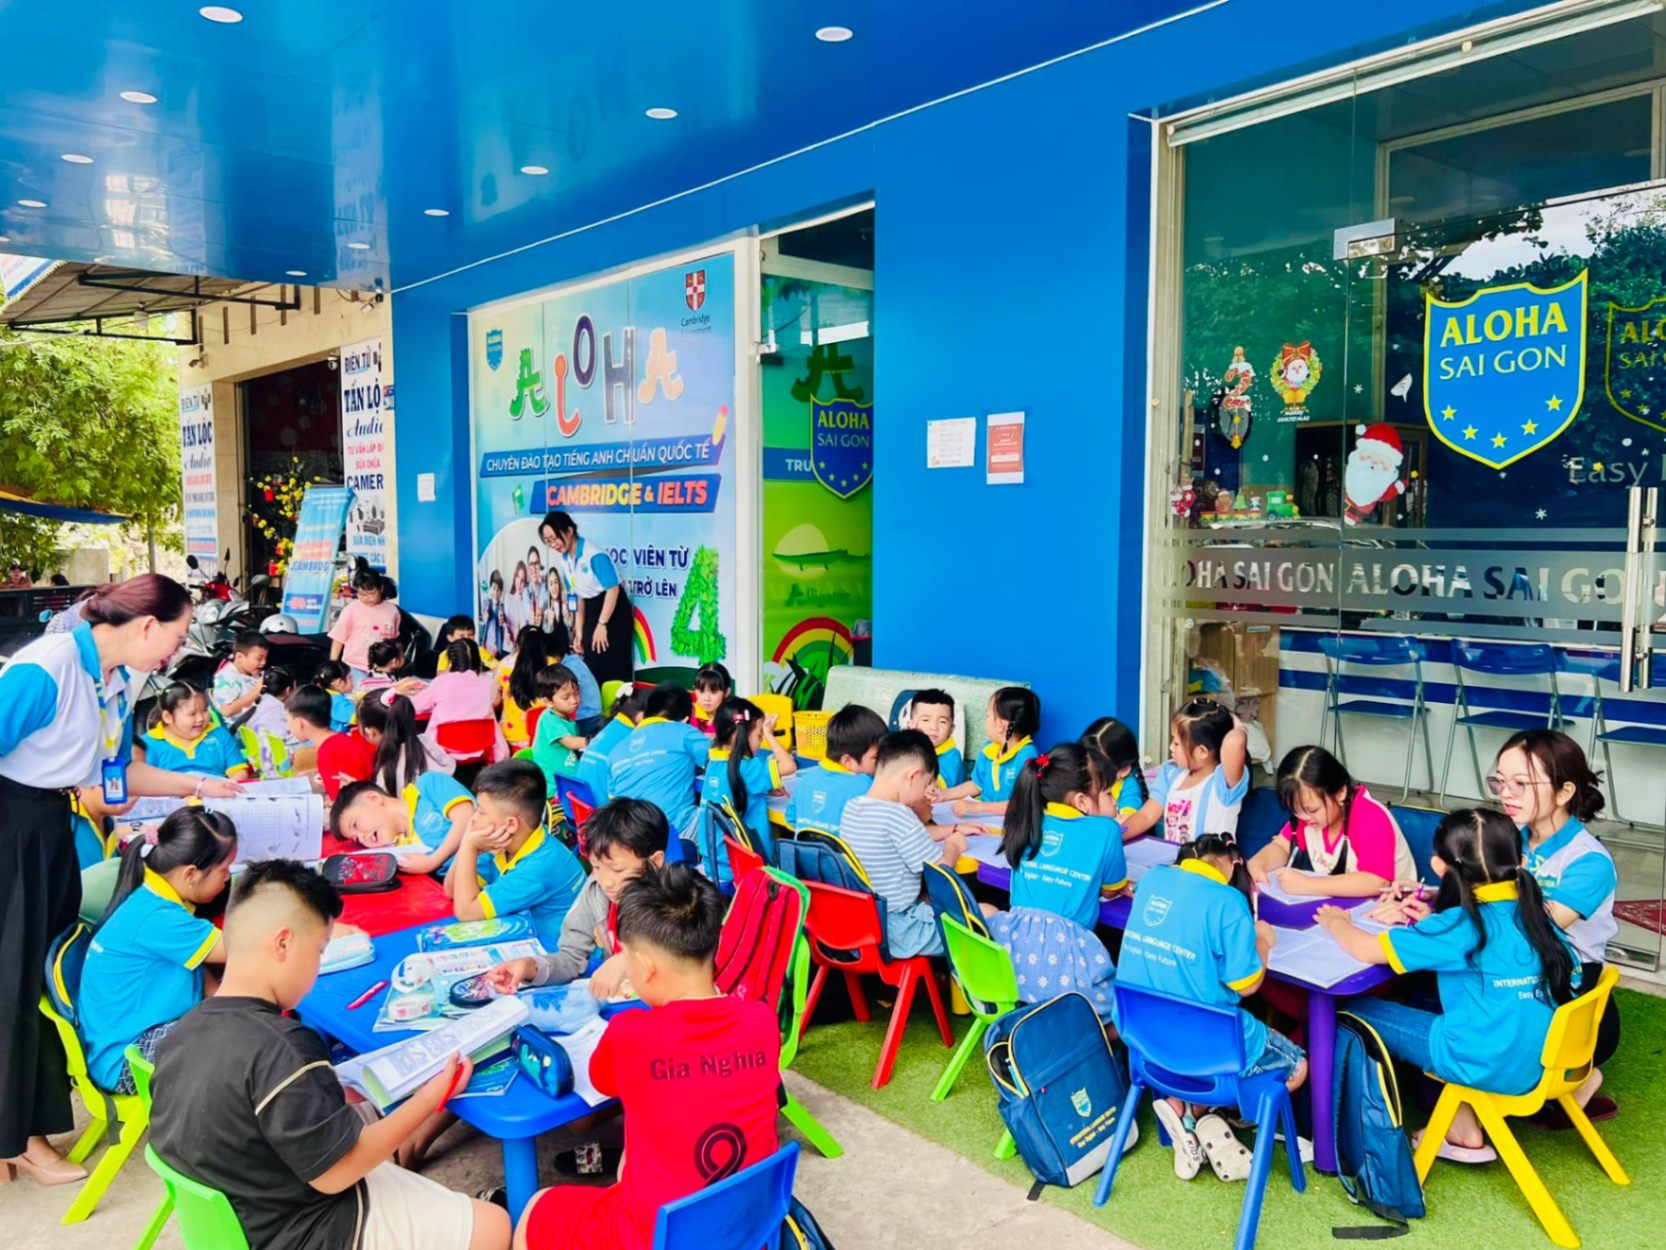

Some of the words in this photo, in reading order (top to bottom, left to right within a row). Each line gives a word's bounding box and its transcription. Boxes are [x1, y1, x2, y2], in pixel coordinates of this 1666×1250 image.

[1440, 302, 1568, 348] ALOHA
[510, 314, 684, 437] ALOHA
[1440, 354, 1485, 380] SAI
[1494, 344, 1567, 375] GON
[367, 378, 382, 415] LỘ
[817, 410, 870, 429] ALOHA
[487, 454, 519, 472] CHUYÊN
[521, 453, 541, 470] ĐÀO
[563, 448, 590, 467] TIẾNG
[591, 450, 614, 465] ANH
[658, 440, 693, 464] QUỐC
[695, 438, 710, 459] TẾ
[817, 433, 838, 448] SAI
[840, 434, 870, 448] GON
[785, 459, 812, 472] TRU
[1569, 456, 1648, 490] Easy
[347, 473, 384, 490] CAMER
[547, 483, 642, 506] CAMBRIDGE
[644, 485, 654, 502] &
[658, 481, 708, 505] IELTS
[633, 544, 665, 567] VIÊN
[669, 545, 690, 568] TỪ
[656, 578, 677, 597] LÊN
[1233, 559, 1272, 591] SAI
[1276, 561, 1336, 594] GON
[1346, 562, 1473, 599] ALOHA
[1483, 565, 1550, 601] SAI
[1561, 567, 1630, 605] GO
[650, 1058, 690, 1082] Gia
